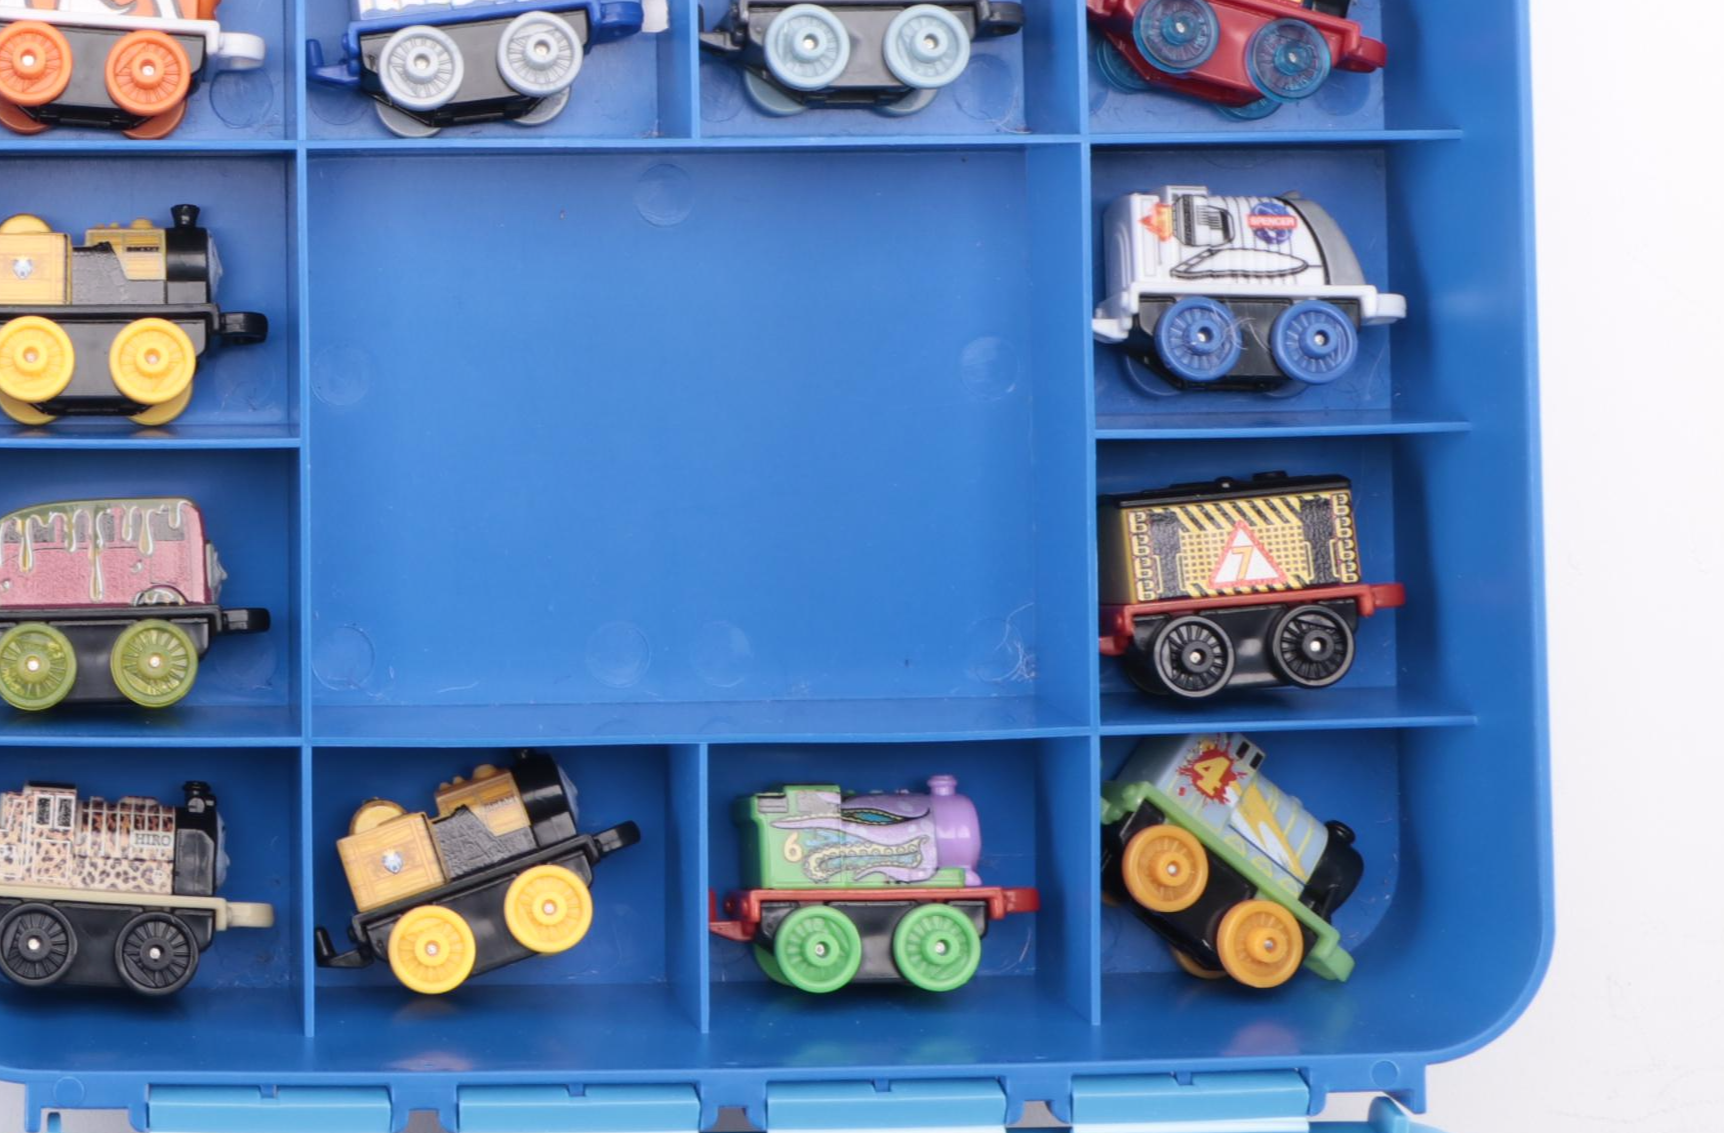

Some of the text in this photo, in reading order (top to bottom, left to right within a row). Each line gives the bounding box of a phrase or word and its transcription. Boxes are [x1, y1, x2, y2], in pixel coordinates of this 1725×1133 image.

[1230, 545, 1255, 581] 7
[1193, 756, 1232, 796] 4
[134, 833, 172, 847] HIRO
[783, 831, 804, 863] 6
